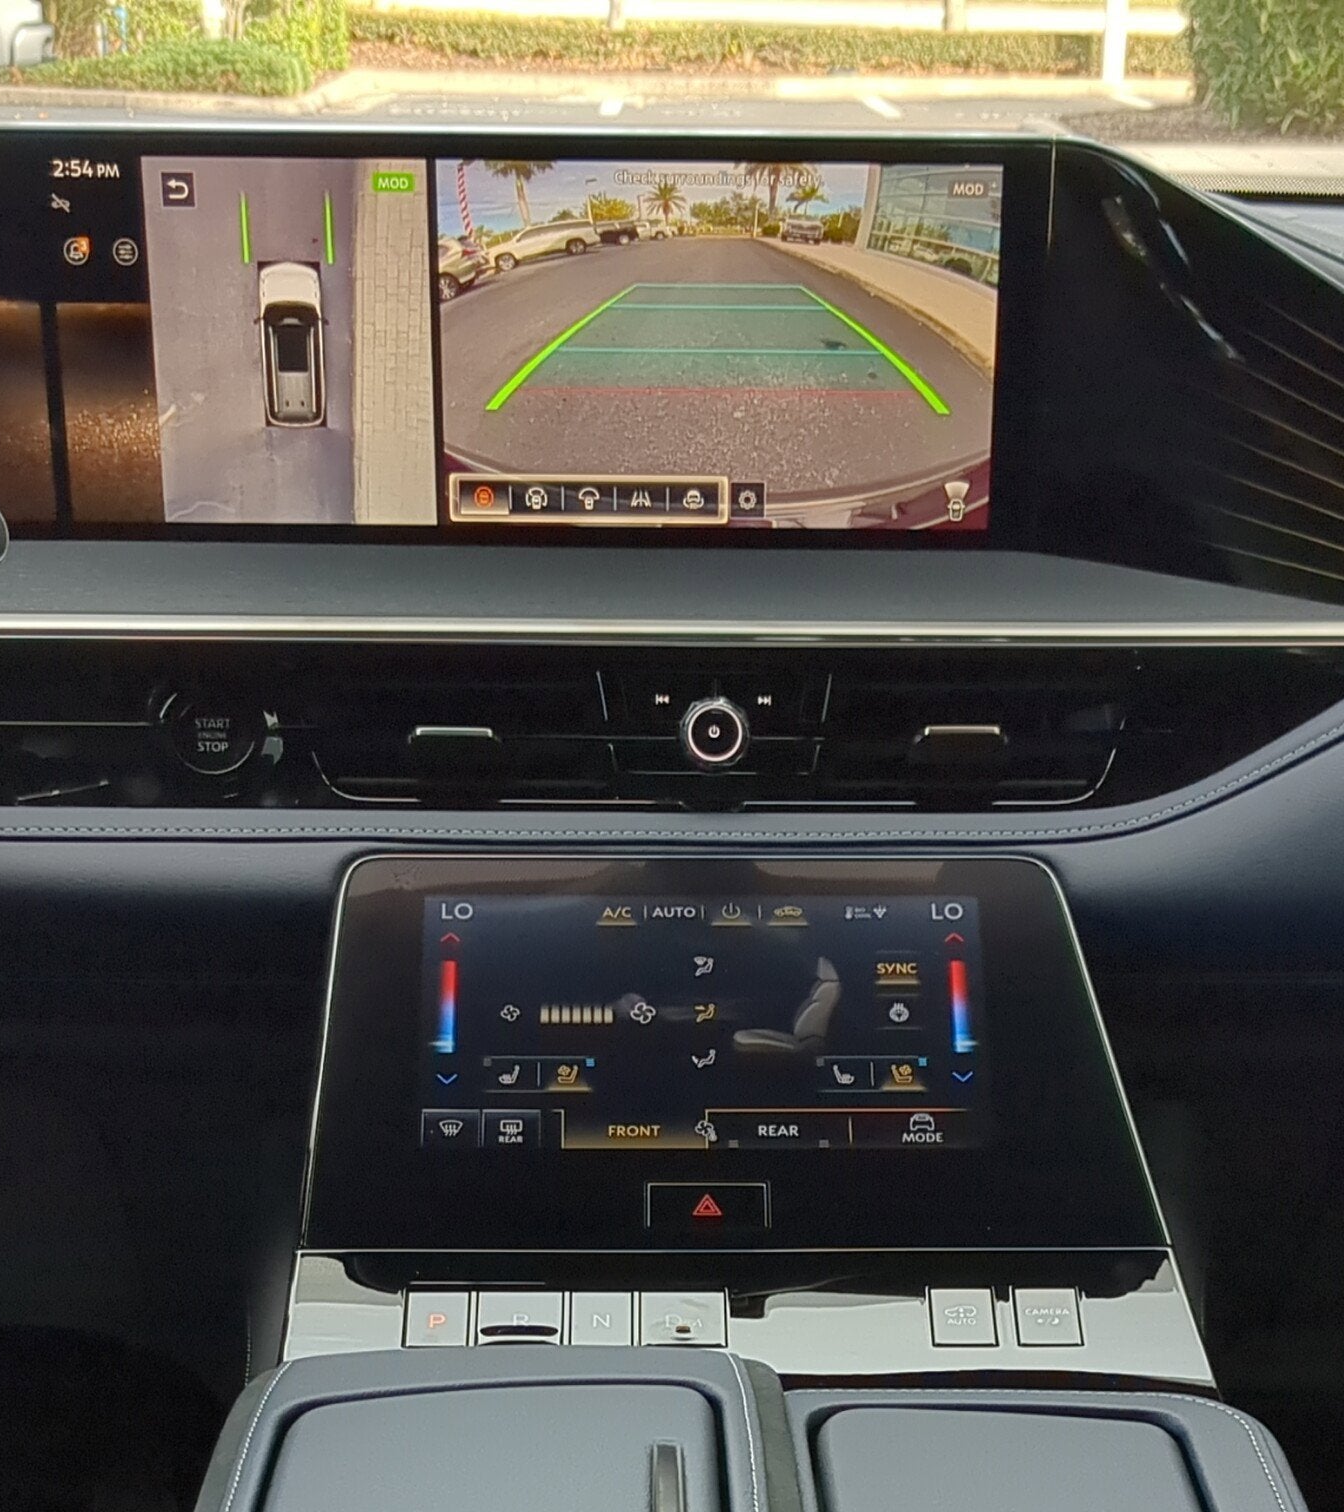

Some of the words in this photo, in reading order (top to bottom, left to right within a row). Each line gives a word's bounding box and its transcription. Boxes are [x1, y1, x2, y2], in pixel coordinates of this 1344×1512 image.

[52, 159, 94, 178] 2:54
[97, 163, 120, 178] PM
[378, 177, 409, 189] MOD
[614, 168, 657, 186] Check
[659, 169, 751, 189] surroundings
[755, 169, 777, 186] for
[953, 182, 985, 195] MOD
[195, 718, 231, 729] START
[197, 741, 230, 752] STOP
[440, 903, 474, 920] LO
[602, 905, 632, 919] A/C
[652, 906, 697, 918] AUTO
[931, 903, 964, 920] LO
[876, 962, 918, 975] SYNC
[608, 1125, 661, 1137] FRONT
[758, 1125, 799, 1137] REAR
[499, 1135, 524, 1144] REAR
[902, 1132, 944, 1144] MODE
[1025, 1307, 1070, 1316] CAMERA
[428, 1314, 446, 1329] P
[592, 1314, 611, 1328] N
[947, 1316, 977, 1326] AUTO
